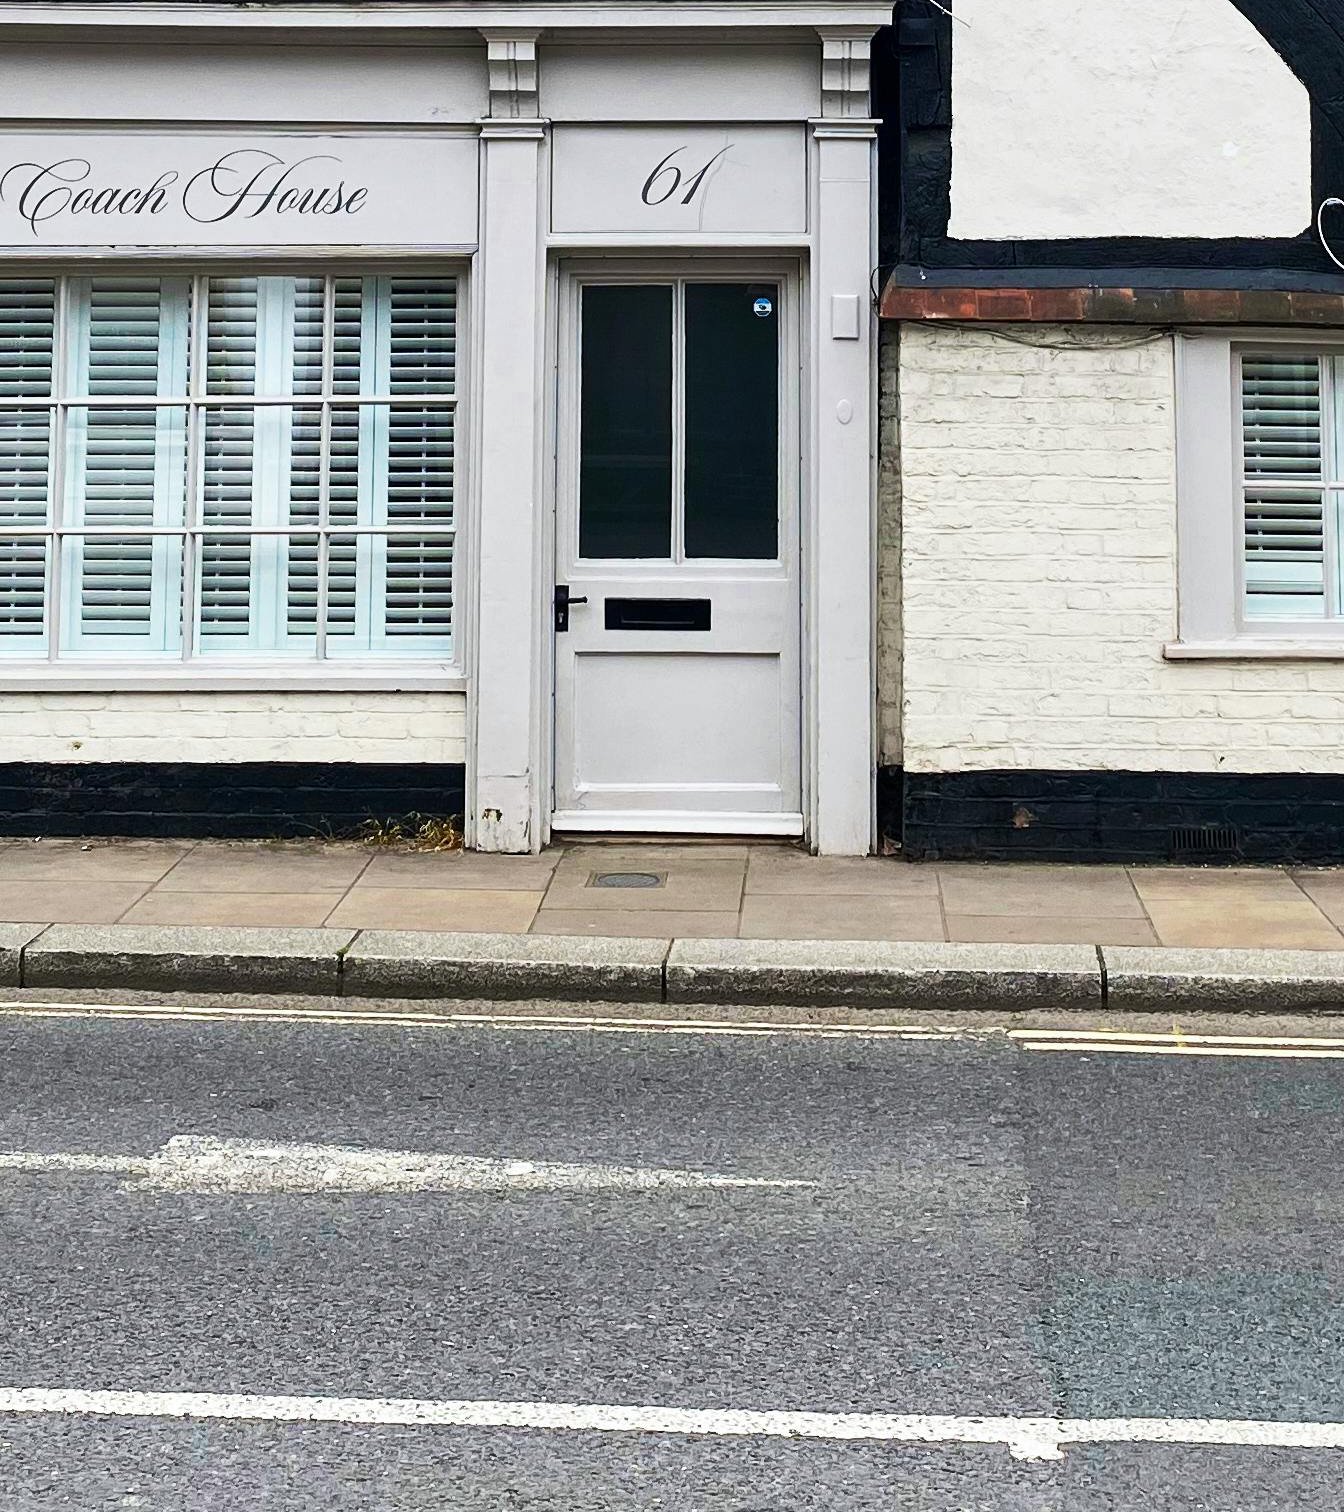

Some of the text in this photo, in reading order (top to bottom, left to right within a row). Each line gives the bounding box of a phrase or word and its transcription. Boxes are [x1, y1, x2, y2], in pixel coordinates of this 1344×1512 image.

[0, 158, 180, 238] Coach
[182, 148, 369, 224] House
[640, 143, 737, 206] 61
